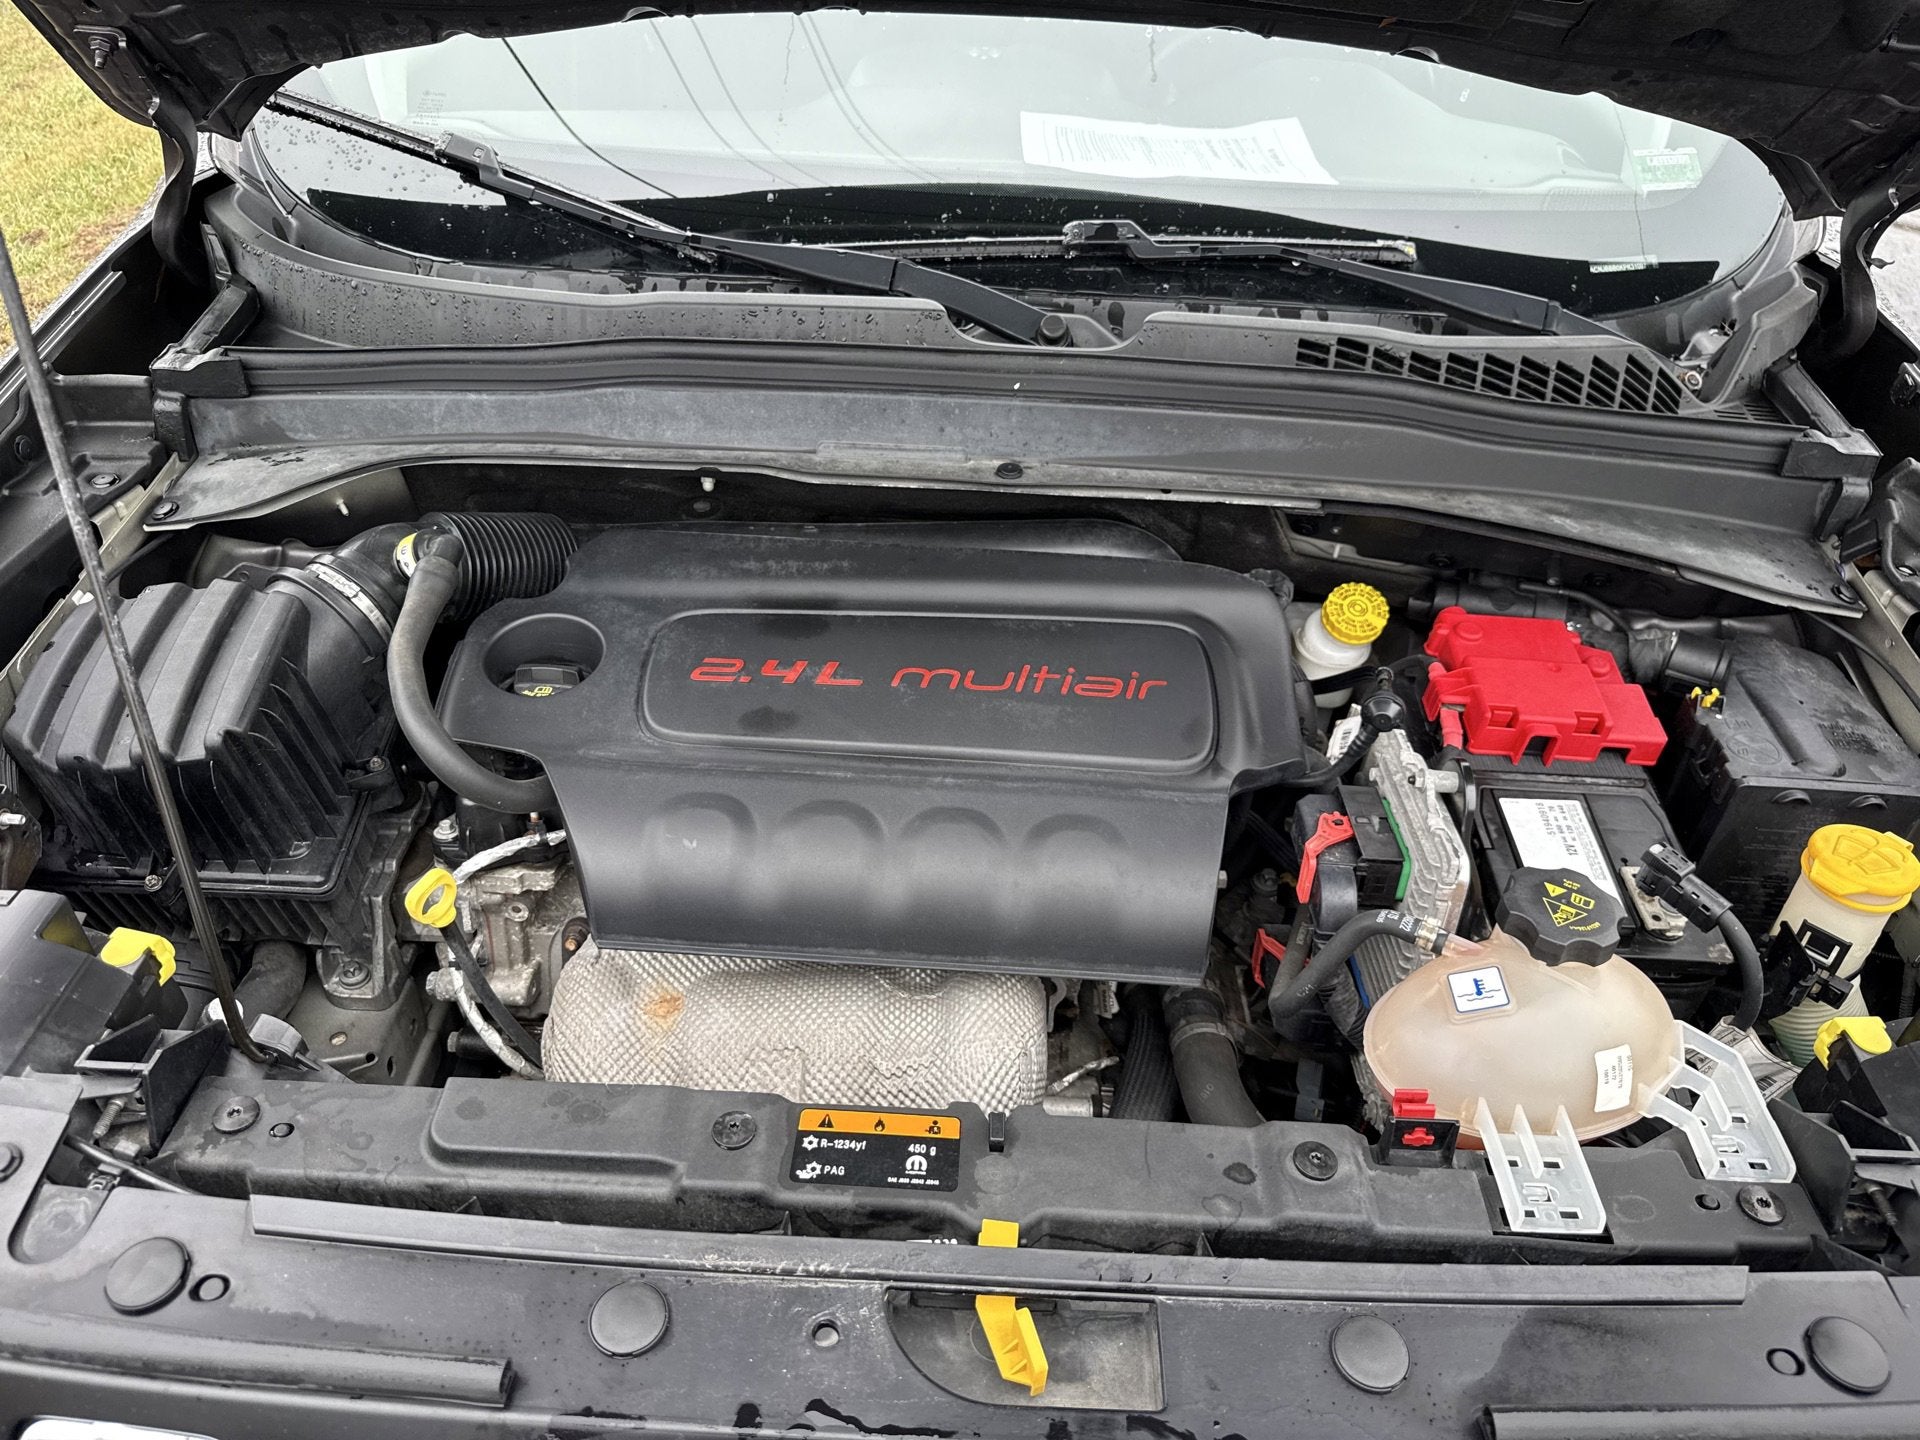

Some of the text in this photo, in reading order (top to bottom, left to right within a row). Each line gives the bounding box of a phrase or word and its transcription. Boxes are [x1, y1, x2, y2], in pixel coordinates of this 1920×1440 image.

[689, 656, 1169, 700] 2.4L multiair
[820, 1138, 867, 1151] R-1234yf
[908, 1143, 937, 1156] 450 g
[823, 1165, 845, 1176] PAG
